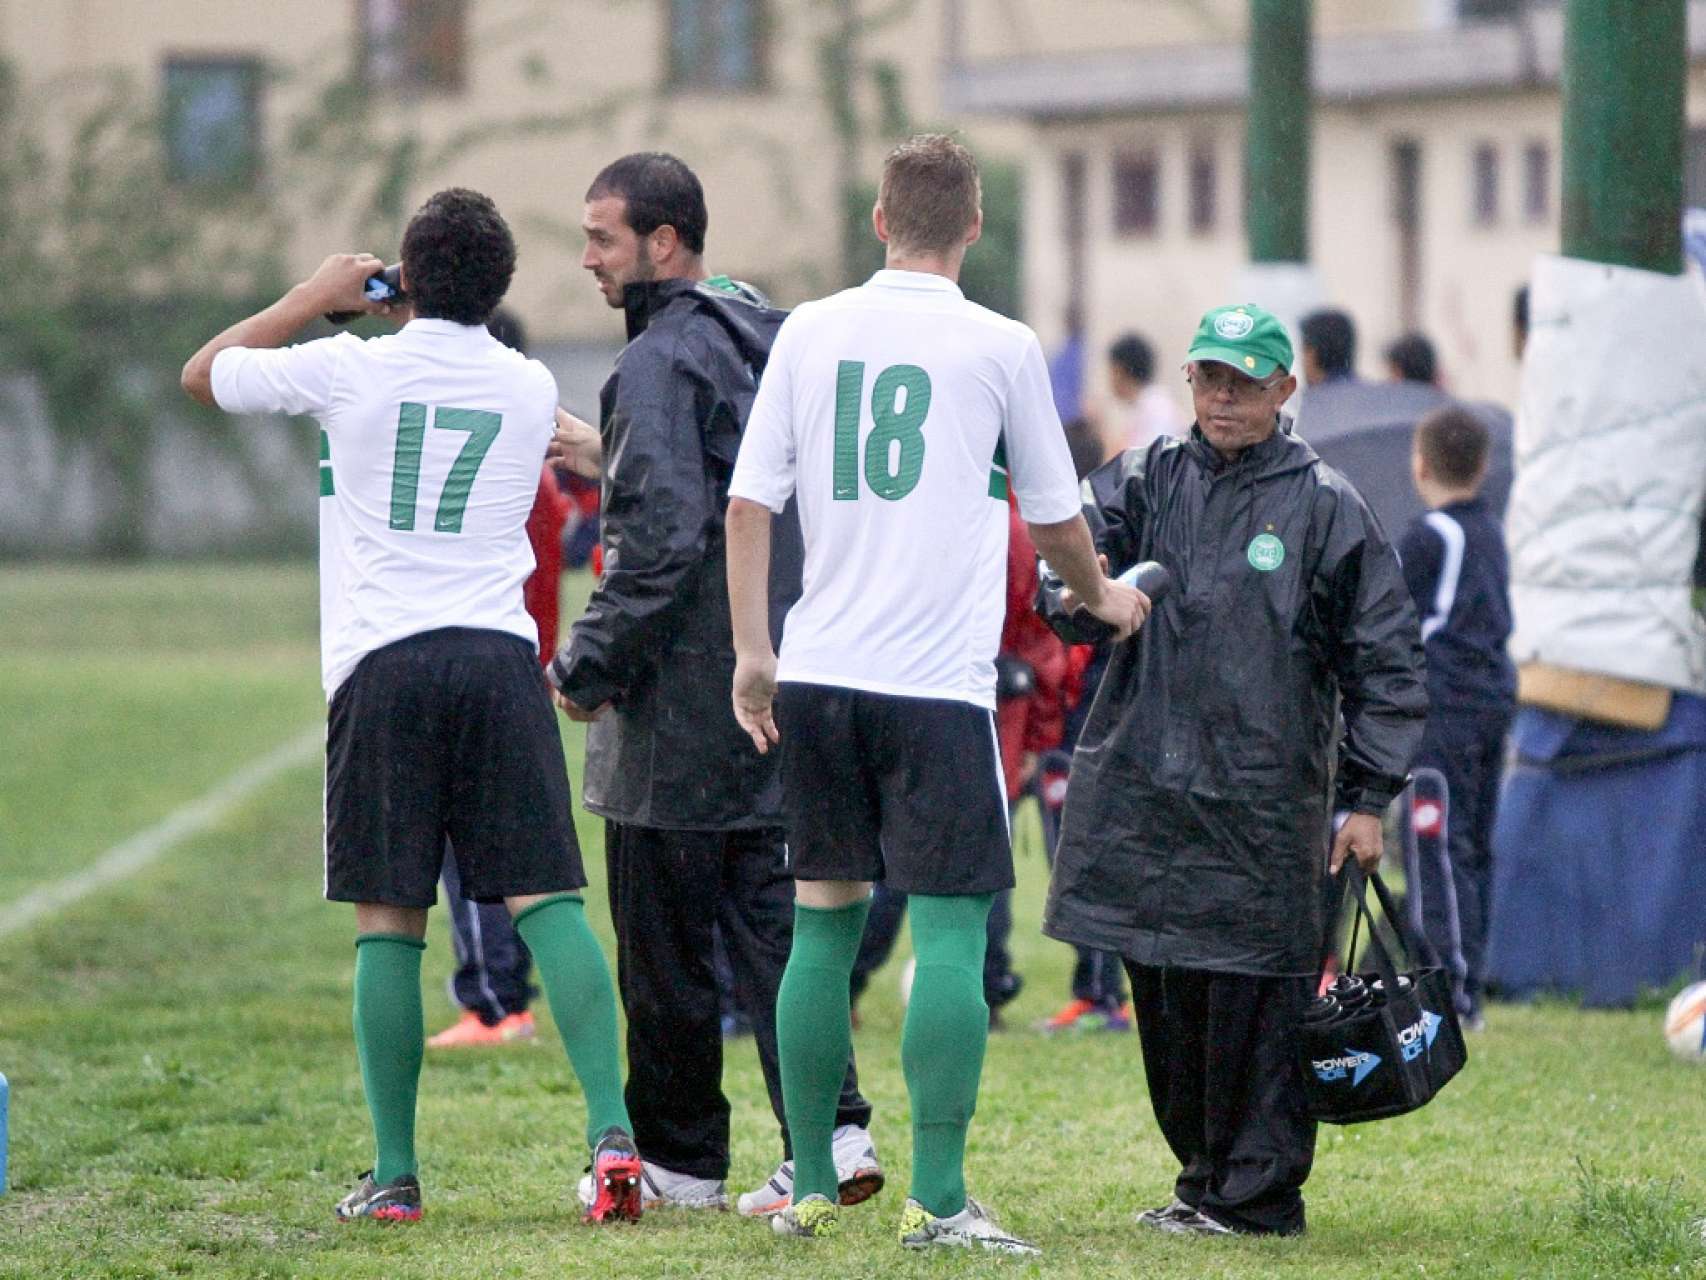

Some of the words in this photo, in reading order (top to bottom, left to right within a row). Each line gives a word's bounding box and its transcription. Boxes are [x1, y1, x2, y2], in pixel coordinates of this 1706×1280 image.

[389, 402, 503, 533] 17
[832, 360, 932, 501] 18
[1312, 1052, 1370, 1071] POWER
